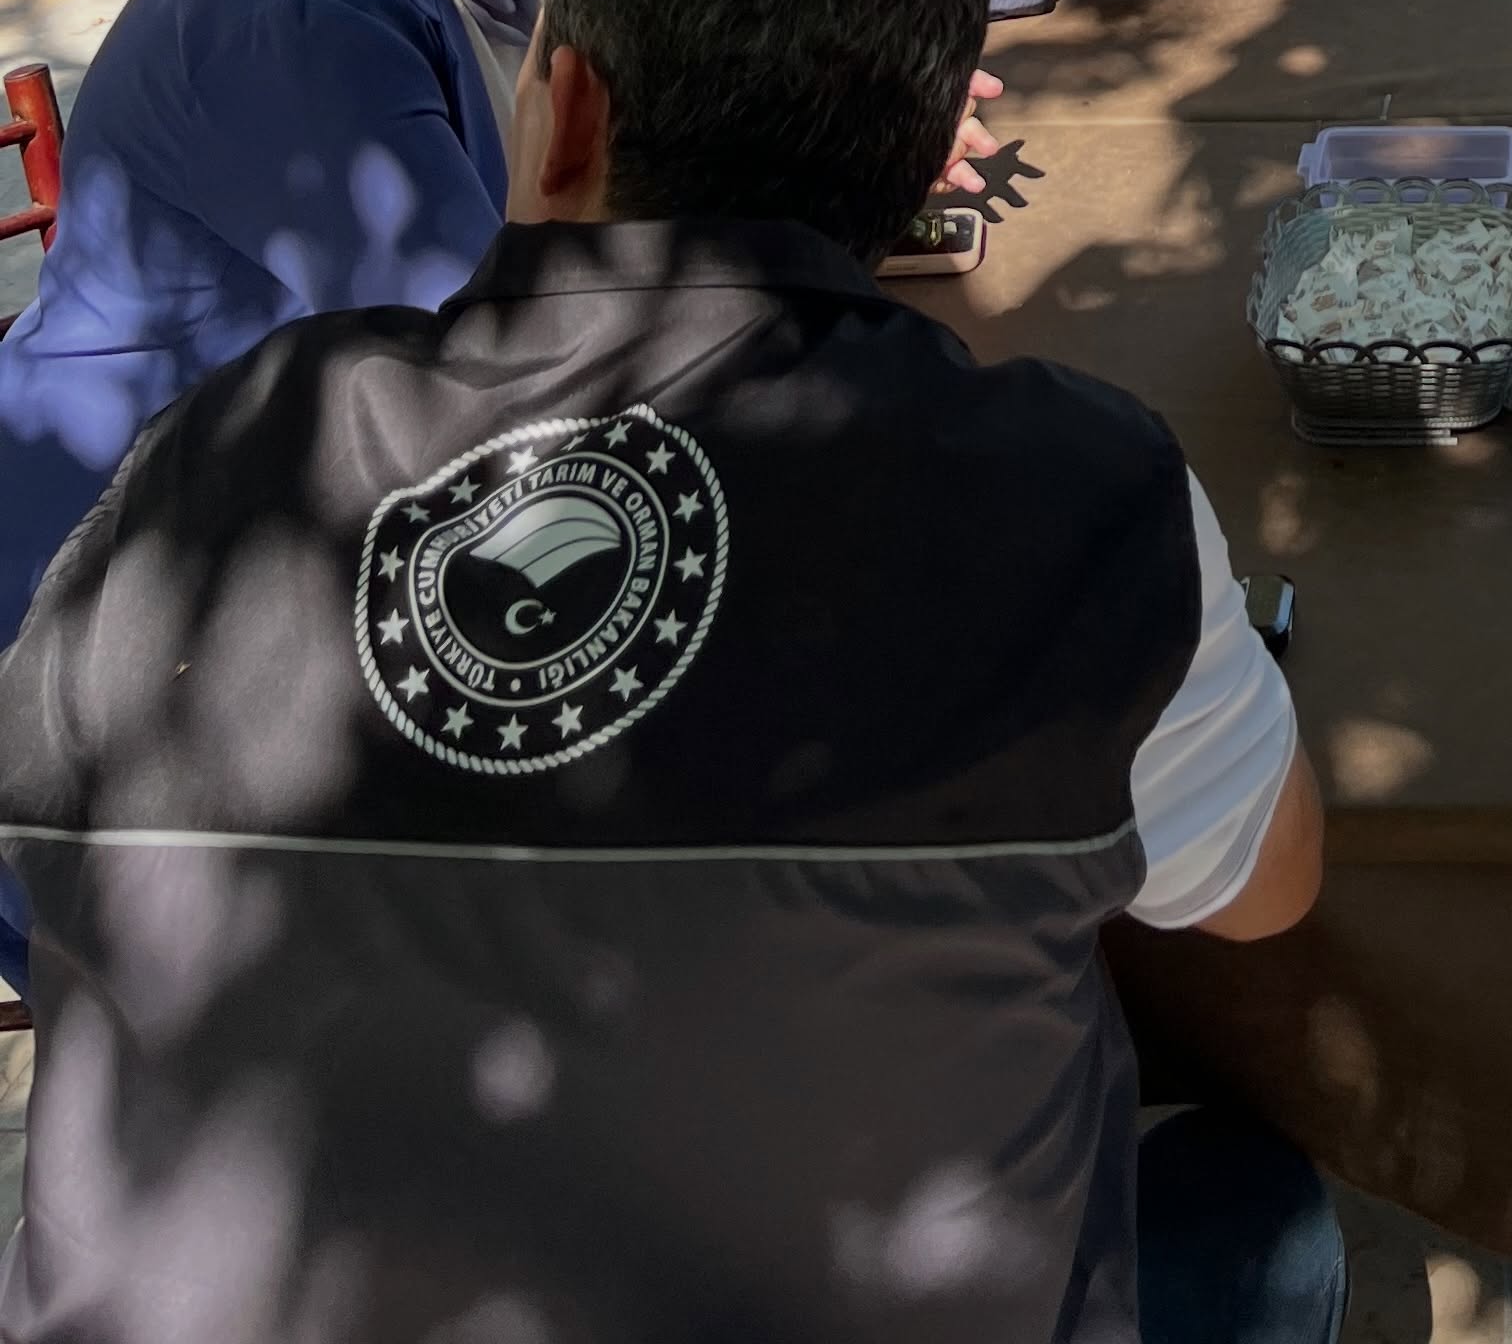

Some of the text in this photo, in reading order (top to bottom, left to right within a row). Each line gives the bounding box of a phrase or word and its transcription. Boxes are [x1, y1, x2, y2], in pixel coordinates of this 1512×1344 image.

[418, 462, 659, 691] TÜRKİYE CUMHURİYETİ TARIM VE ORMAN BAKANLIĞI
